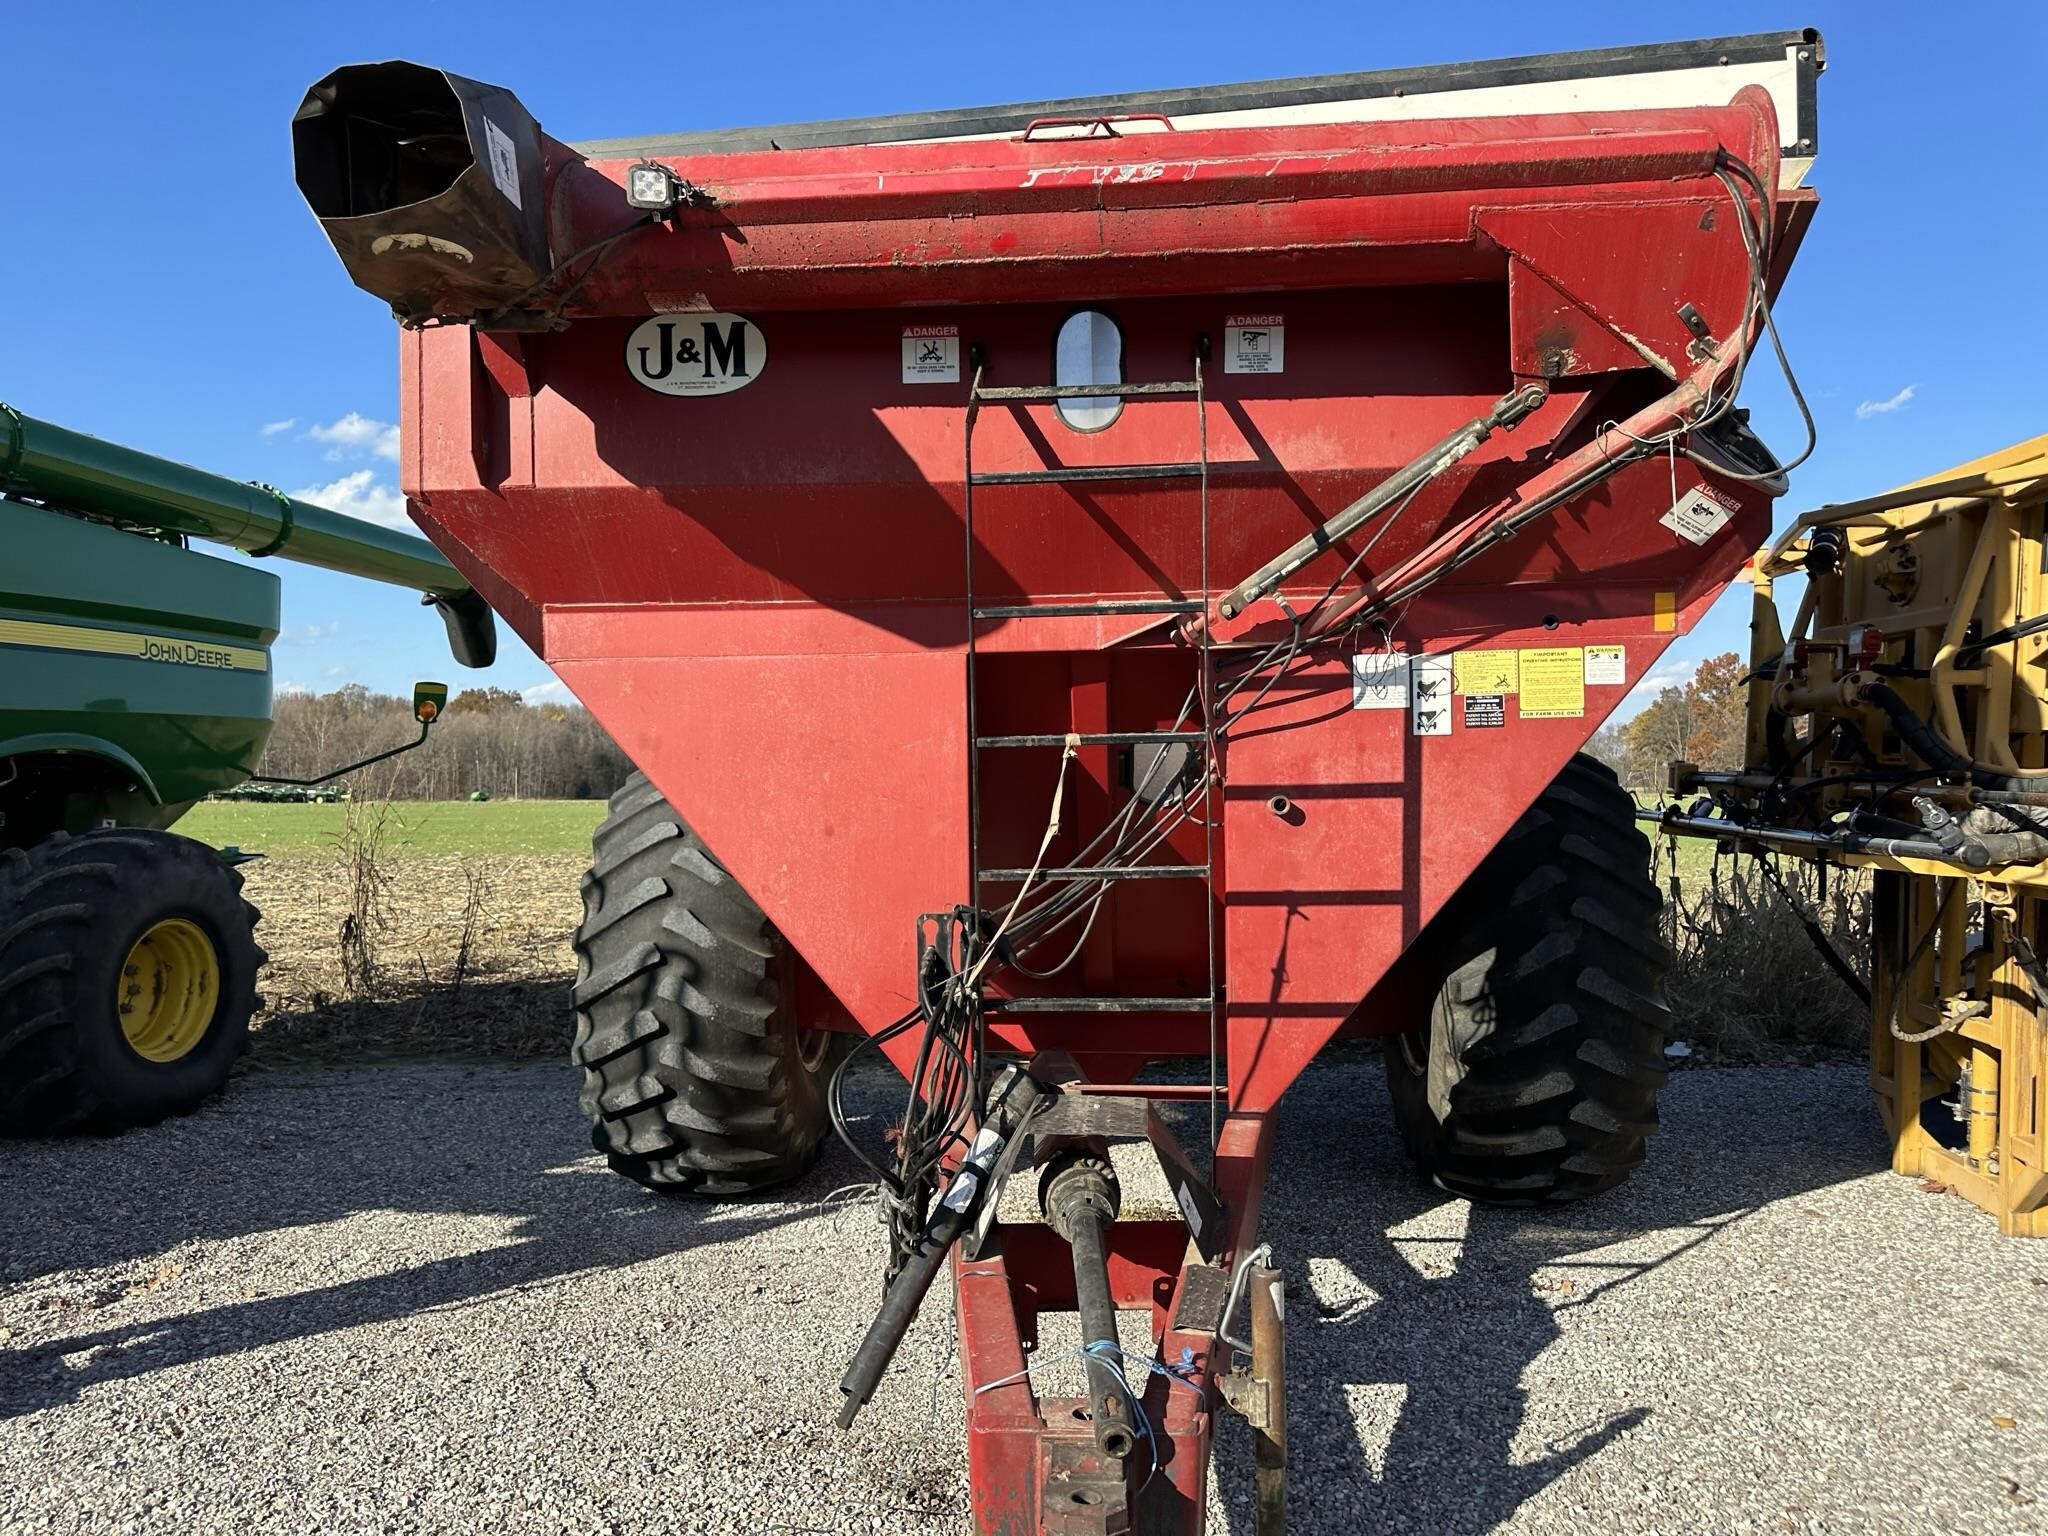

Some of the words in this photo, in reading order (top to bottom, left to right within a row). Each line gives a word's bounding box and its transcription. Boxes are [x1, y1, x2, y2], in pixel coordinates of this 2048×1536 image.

[913, 327, 958, 336] DANGER
[1237, 316, 1282, 326] DANGER
[637, 321, 749, 379] J&M
[1704, 485, 1741, 511] DANGER
[140, 638, 182, 660] JOHN
[185, 645, 233, 667] DEERE
